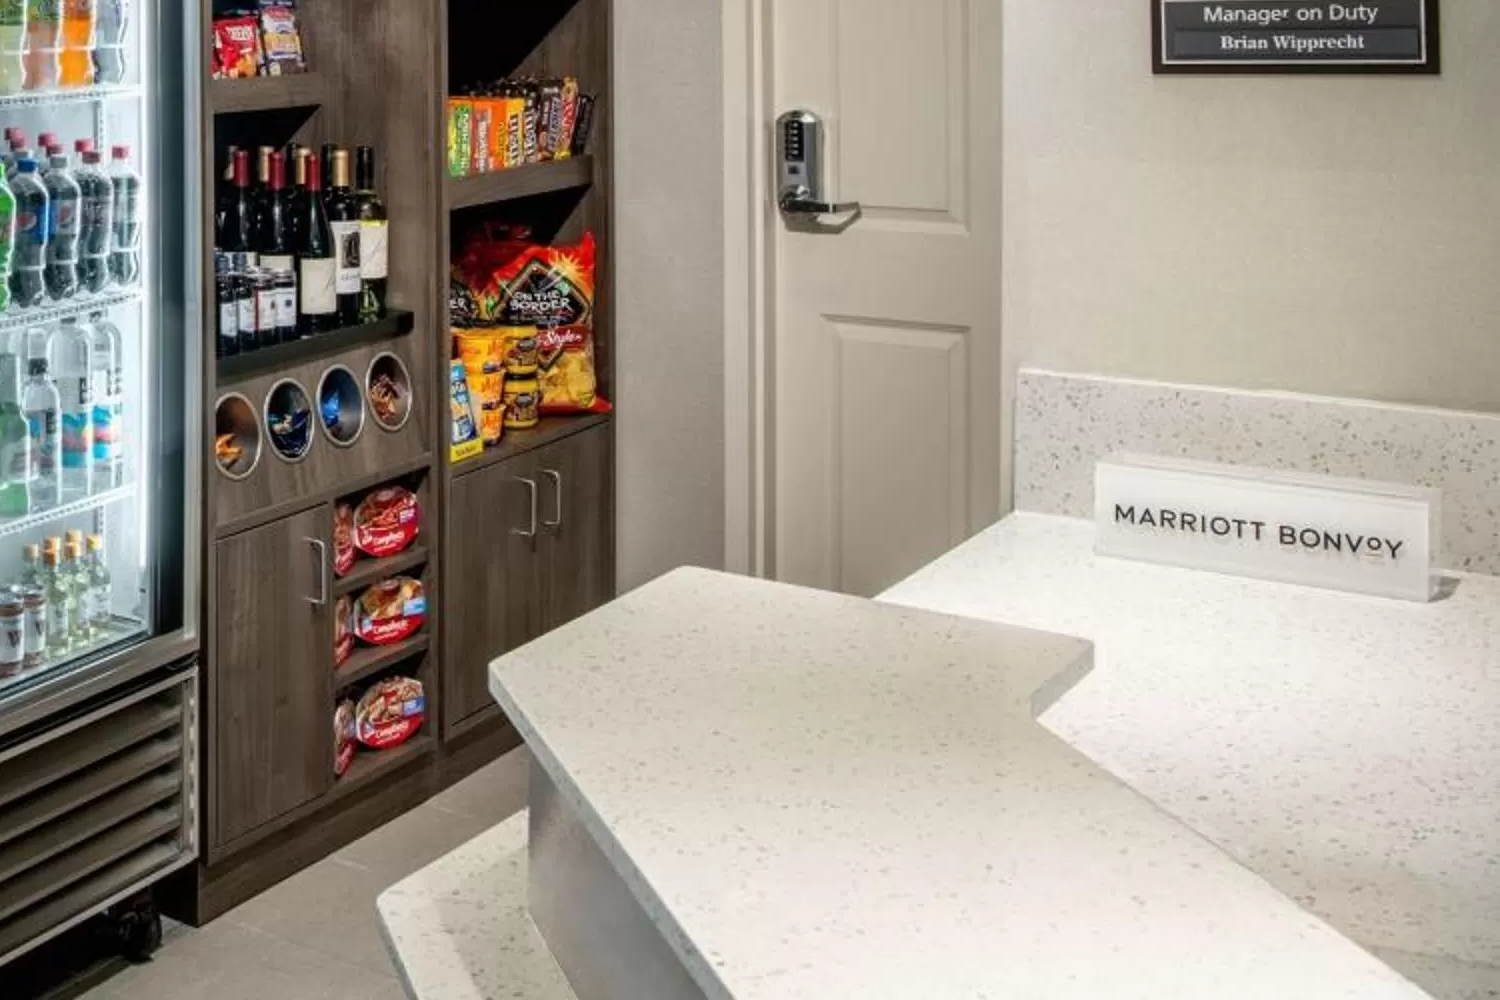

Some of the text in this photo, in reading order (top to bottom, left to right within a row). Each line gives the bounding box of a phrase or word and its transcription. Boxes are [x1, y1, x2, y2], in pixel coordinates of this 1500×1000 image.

[1203, 4, 1379, 25] Manager on Duty
[1220, 34, 1365, 52] Brian Wipprecht
[511, 298, 573, 313] BORDER
[514, 292, 532, 301] ON
[1115, 503, 1404, 560] MARRIOTT BONVOY
